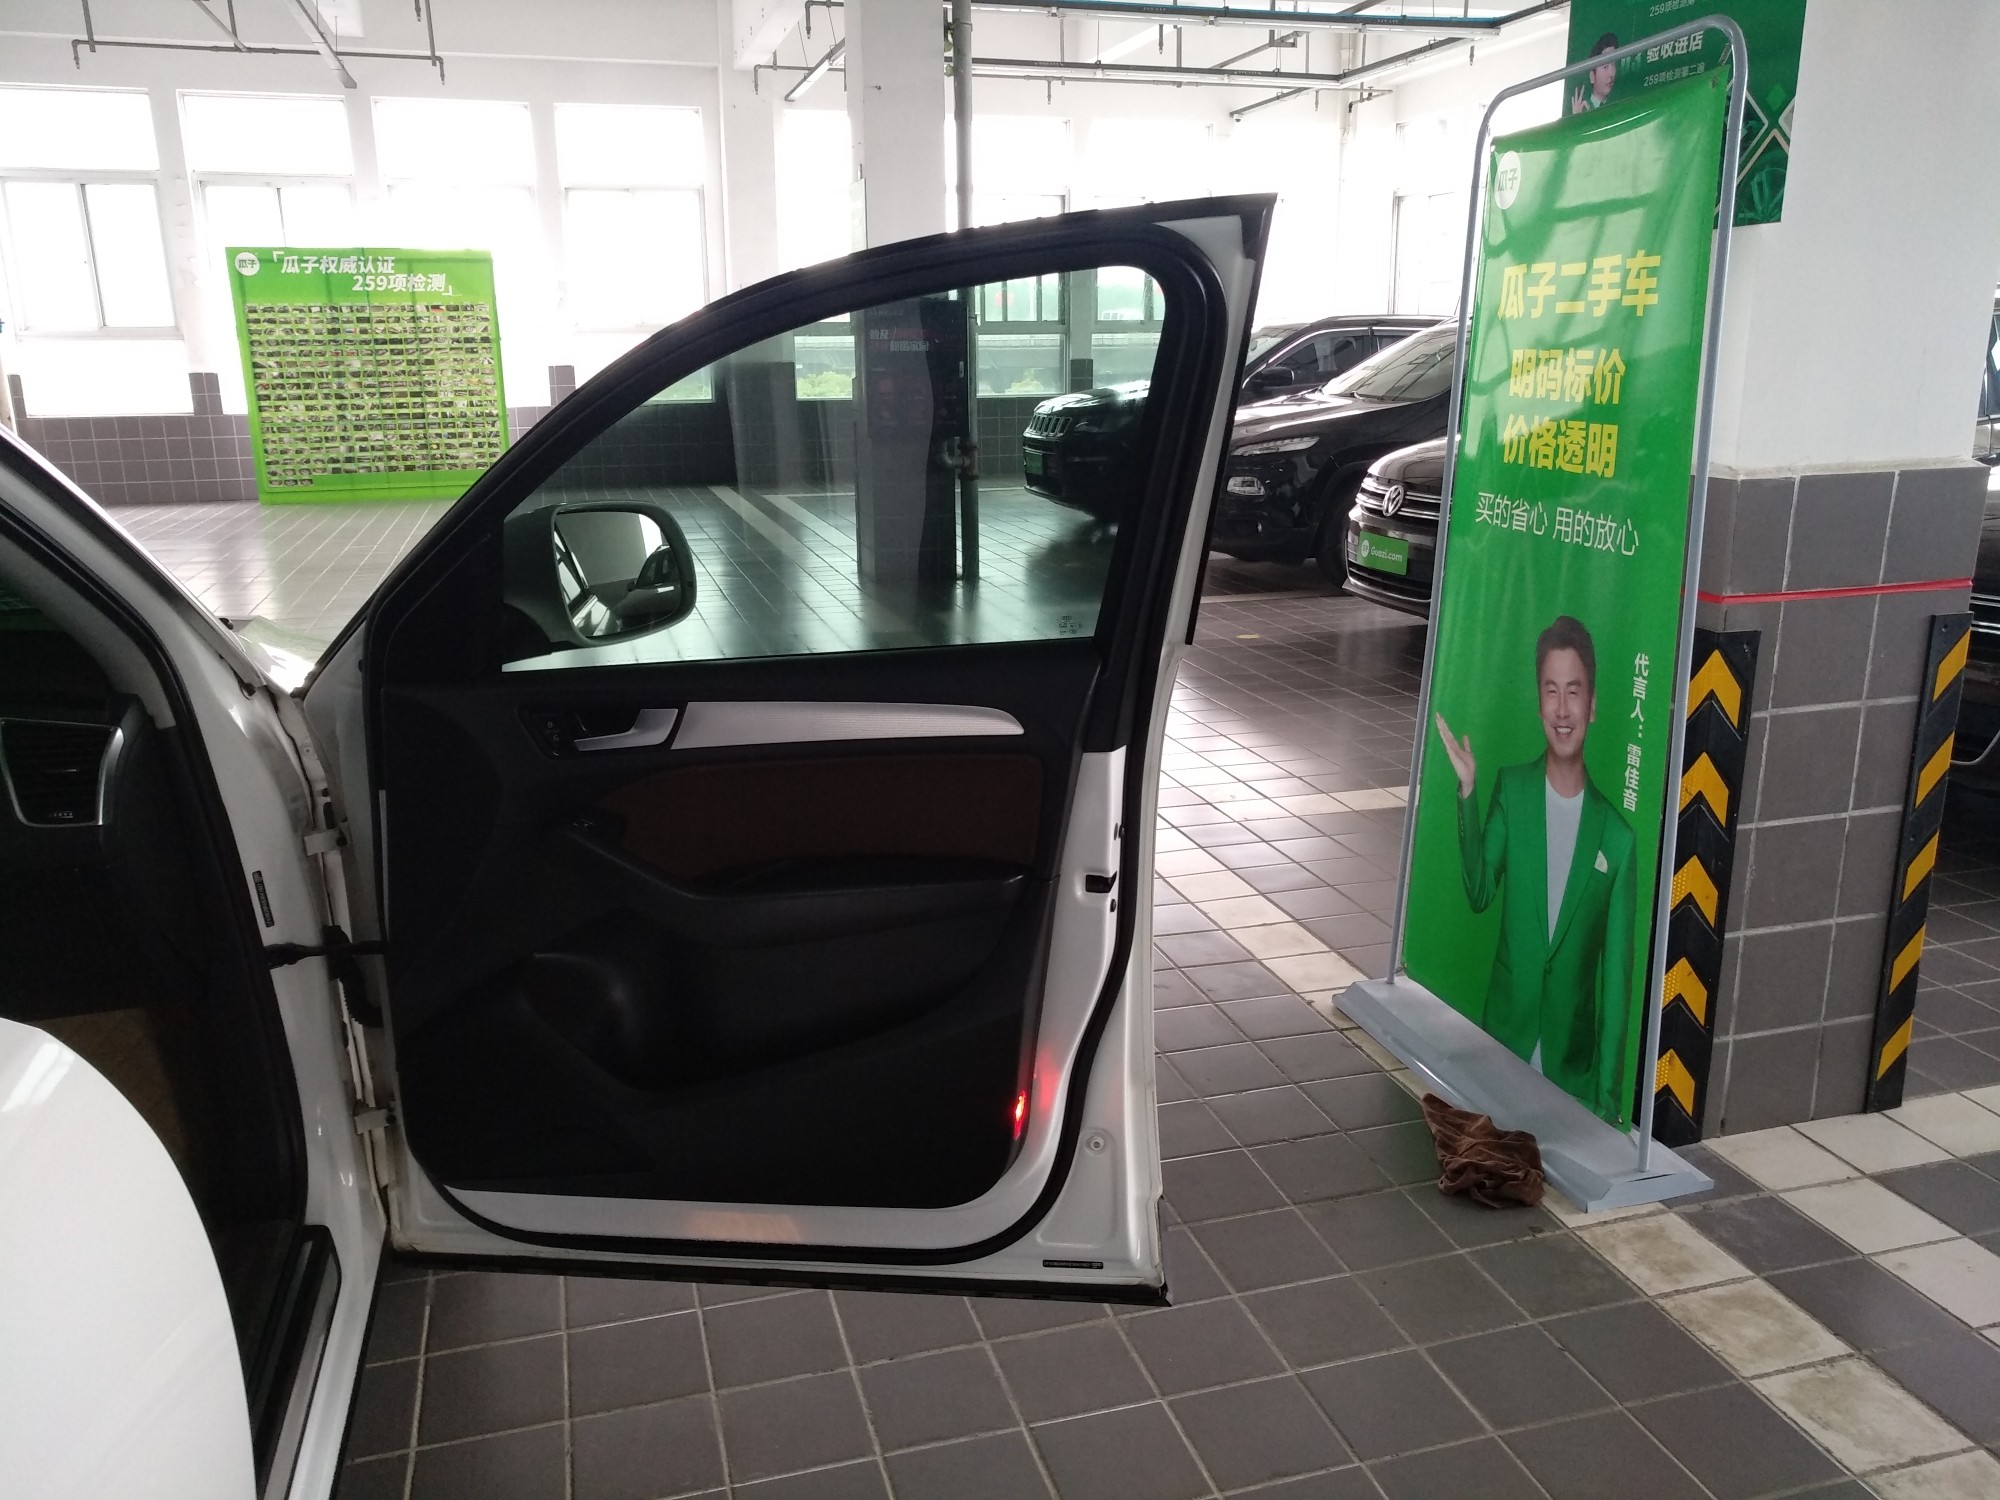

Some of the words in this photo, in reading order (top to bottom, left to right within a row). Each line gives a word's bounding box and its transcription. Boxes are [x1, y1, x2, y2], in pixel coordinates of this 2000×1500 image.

[1646, 31, 1704, 63] 验收进店
[1497, 249, 1662, 319] 瓜子二手车
[1508, 347, 1626, 405] 明码标价
[1502, 413, 1619, 478] 价格透明
[1475, 491, 1548, 536] 买的省心
[1552, 506, 1639, 557] 用的放心
